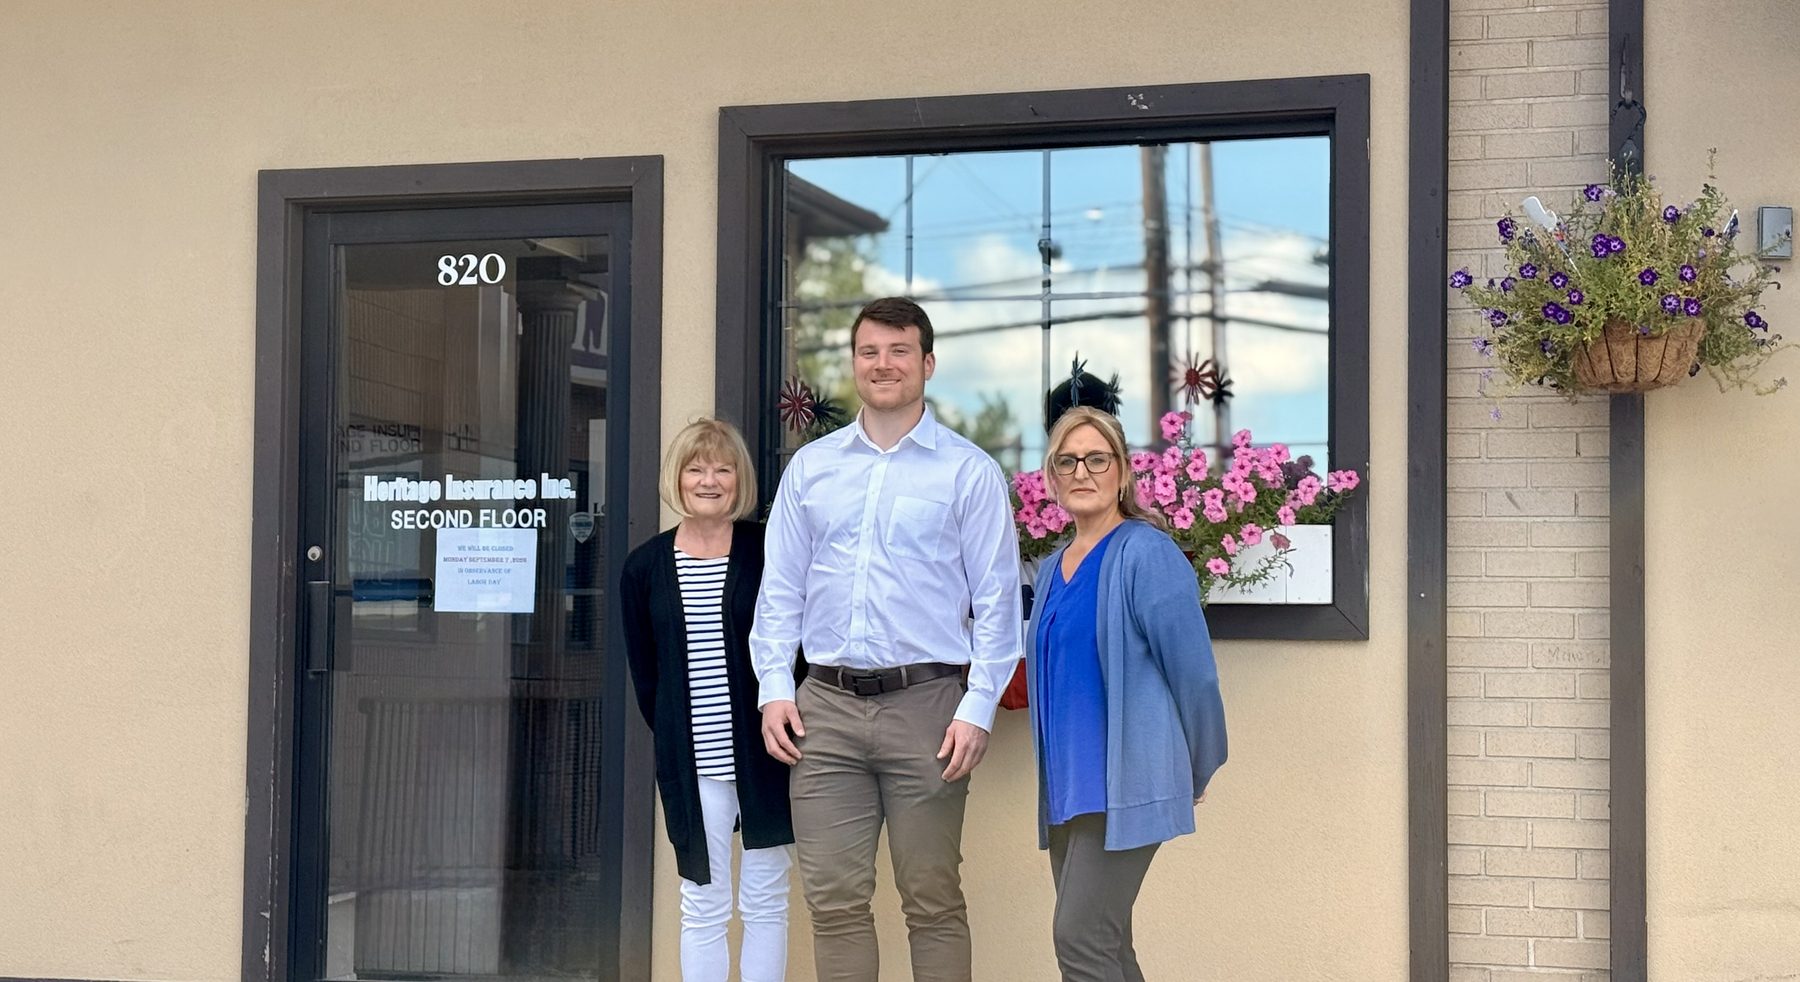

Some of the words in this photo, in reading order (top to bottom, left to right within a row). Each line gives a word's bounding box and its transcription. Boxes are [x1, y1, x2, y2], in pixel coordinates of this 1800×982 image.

[437, 253, 506, 286] 820
[364, 475, 442, 504] Heritage
[446, 473, 537, 500] Insurance
[541, 472, 576, 499] Inc.
[391, 508, 473, 530] SECOND
[479, 507, 547, 529] FLOOR
